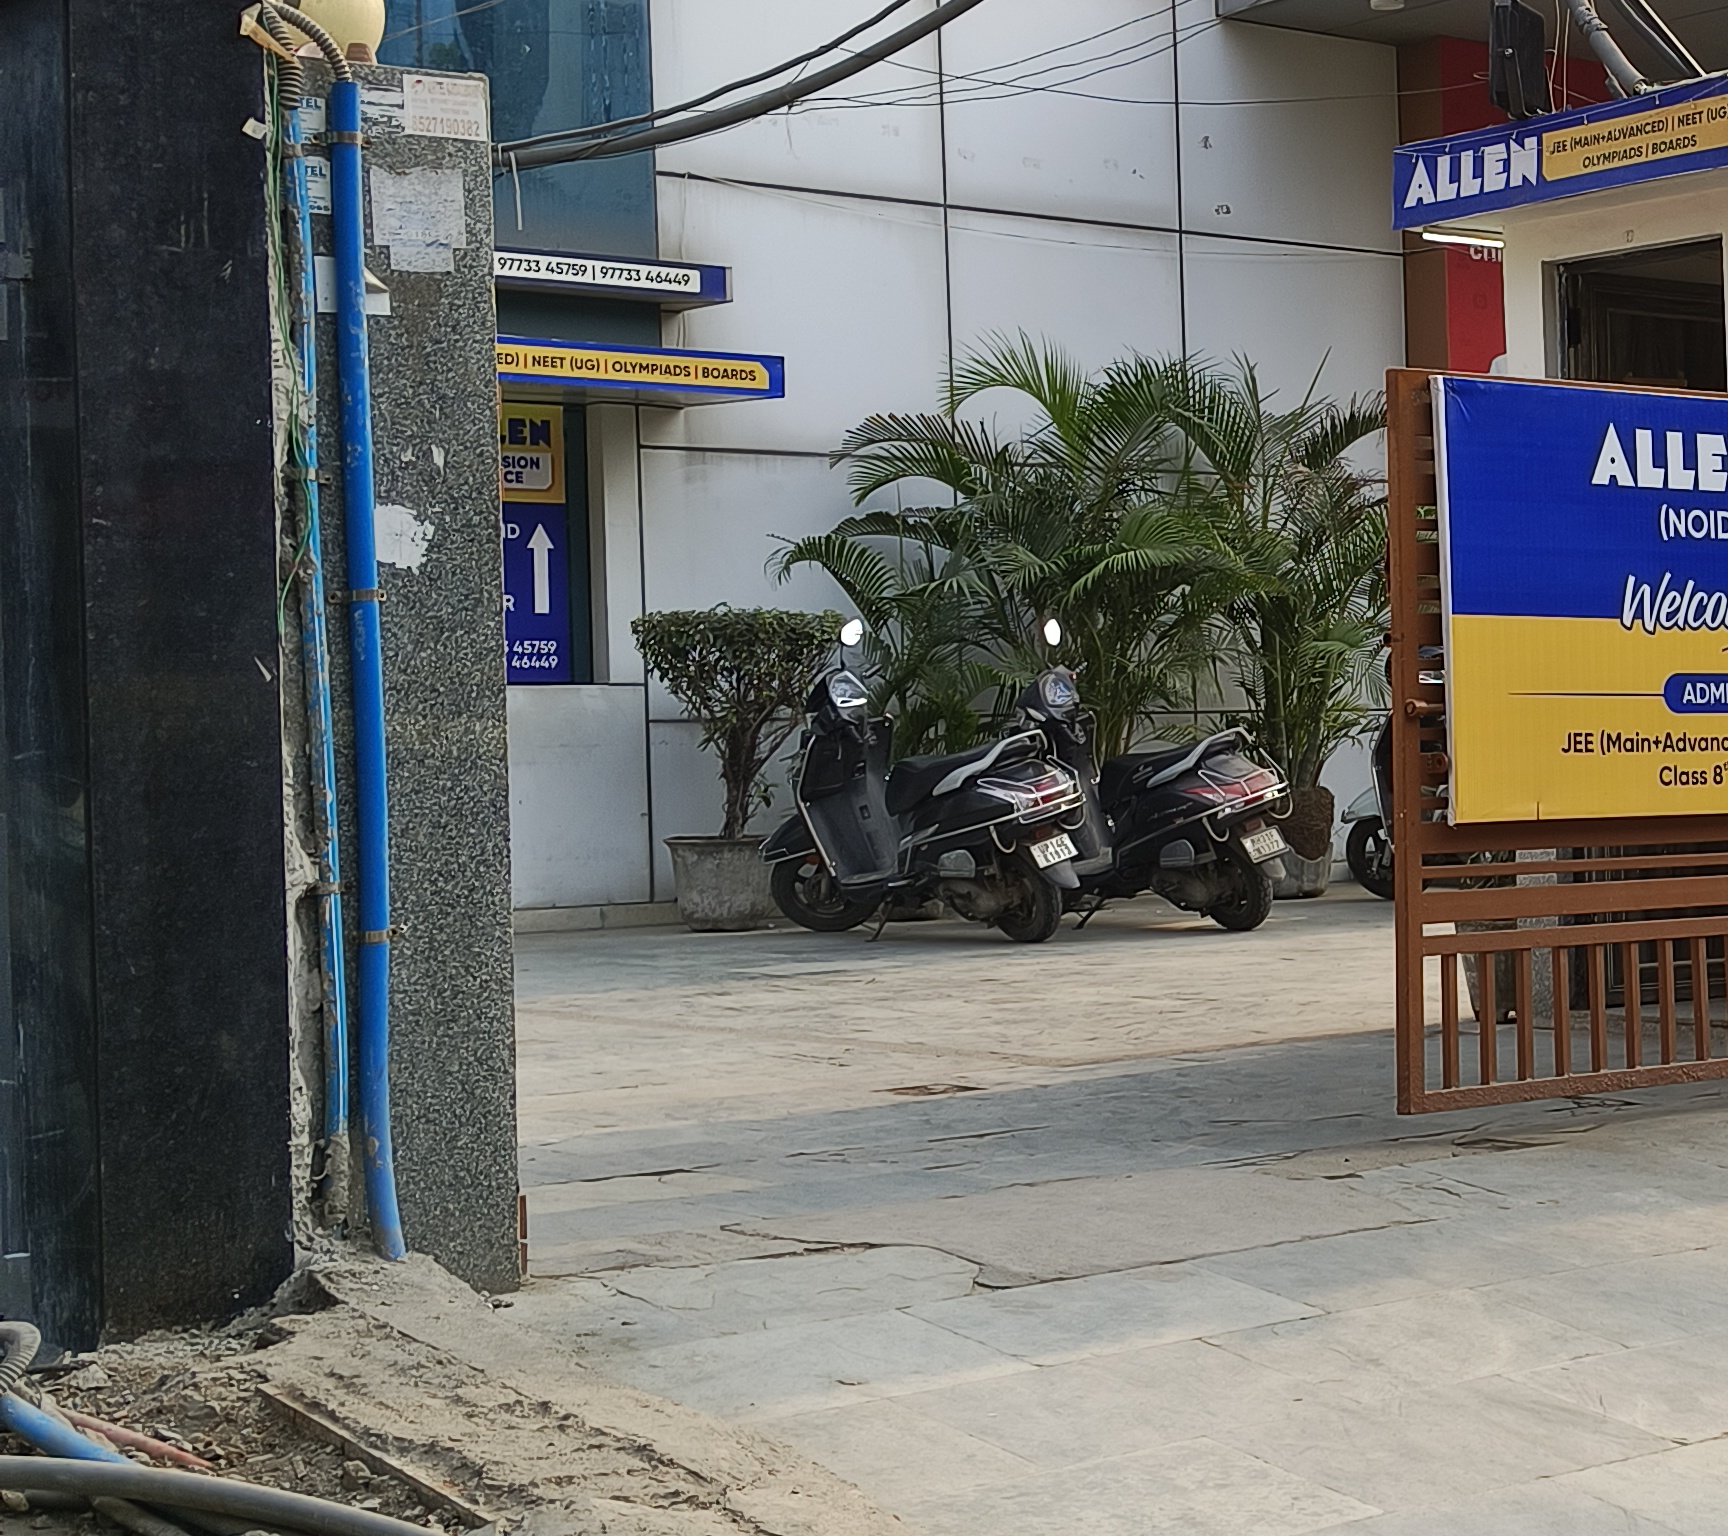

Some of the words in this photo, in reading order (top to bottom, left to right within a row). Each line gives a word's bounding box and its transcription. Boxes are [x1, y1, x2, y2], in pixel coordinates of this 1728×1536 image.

[1550, 139, 1568, 156] JEE
[1569, 116, 1669, 153] (MAIN+ADVANCED)
[1677, 110, 1704, 128] NEET
[1582, 140, 1643, 170] OLYMPIADS
[1651, 134, 1697, 156] BOARDS
[1403, 135, 1539, 209] ALLEN
[497, 256, 541, 272] 97733
[545, 261, 588, 277] 45759
[600, 266, 641, 282] 97733
[645, 270, 691, 287] 46449
[531, 355, 566, 370] NEET
[569, 356, 600, 373] (UG)
[611, 360, 692, 378] OLYMPIADS
[701, 365, 757, 382] BOARDS
[513, 640, 557, 654] 45759
[511, 654, 558, 670] 46449
[1561, 732, 1595, 754] JEE
[1658, 765, 1708, 786] Class
